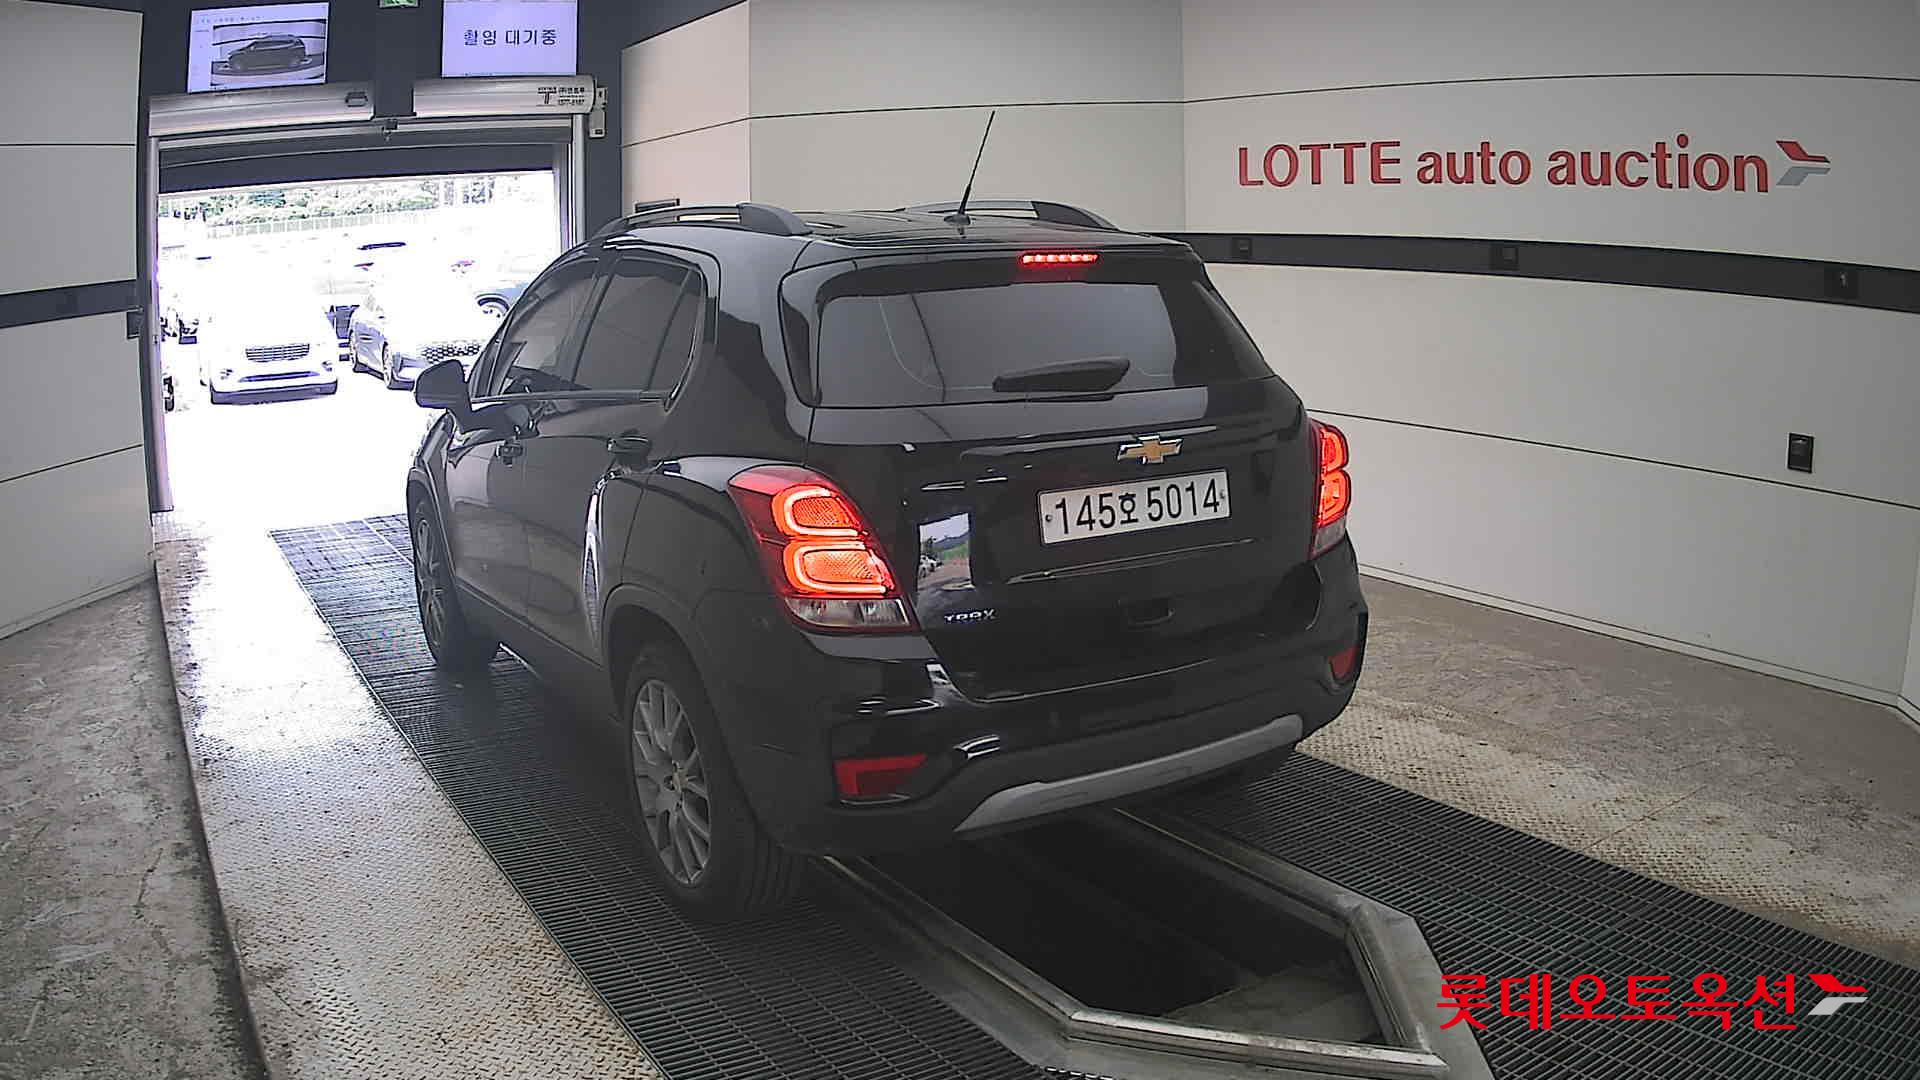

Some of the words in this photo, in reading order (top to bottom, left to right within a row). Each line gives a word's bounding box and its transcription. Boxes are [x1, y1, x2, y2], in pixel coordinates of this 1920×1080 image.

[505, 29, 557, 46] 대기중
[1238, 141, 1401, 187] LOTTE
[1416, 141, 1532, 185] auto
[1547, 133, 1769, 193] auction
[1055, 492, 1139, 534] 145호
[1147, 478, 1220, 522] 5014
